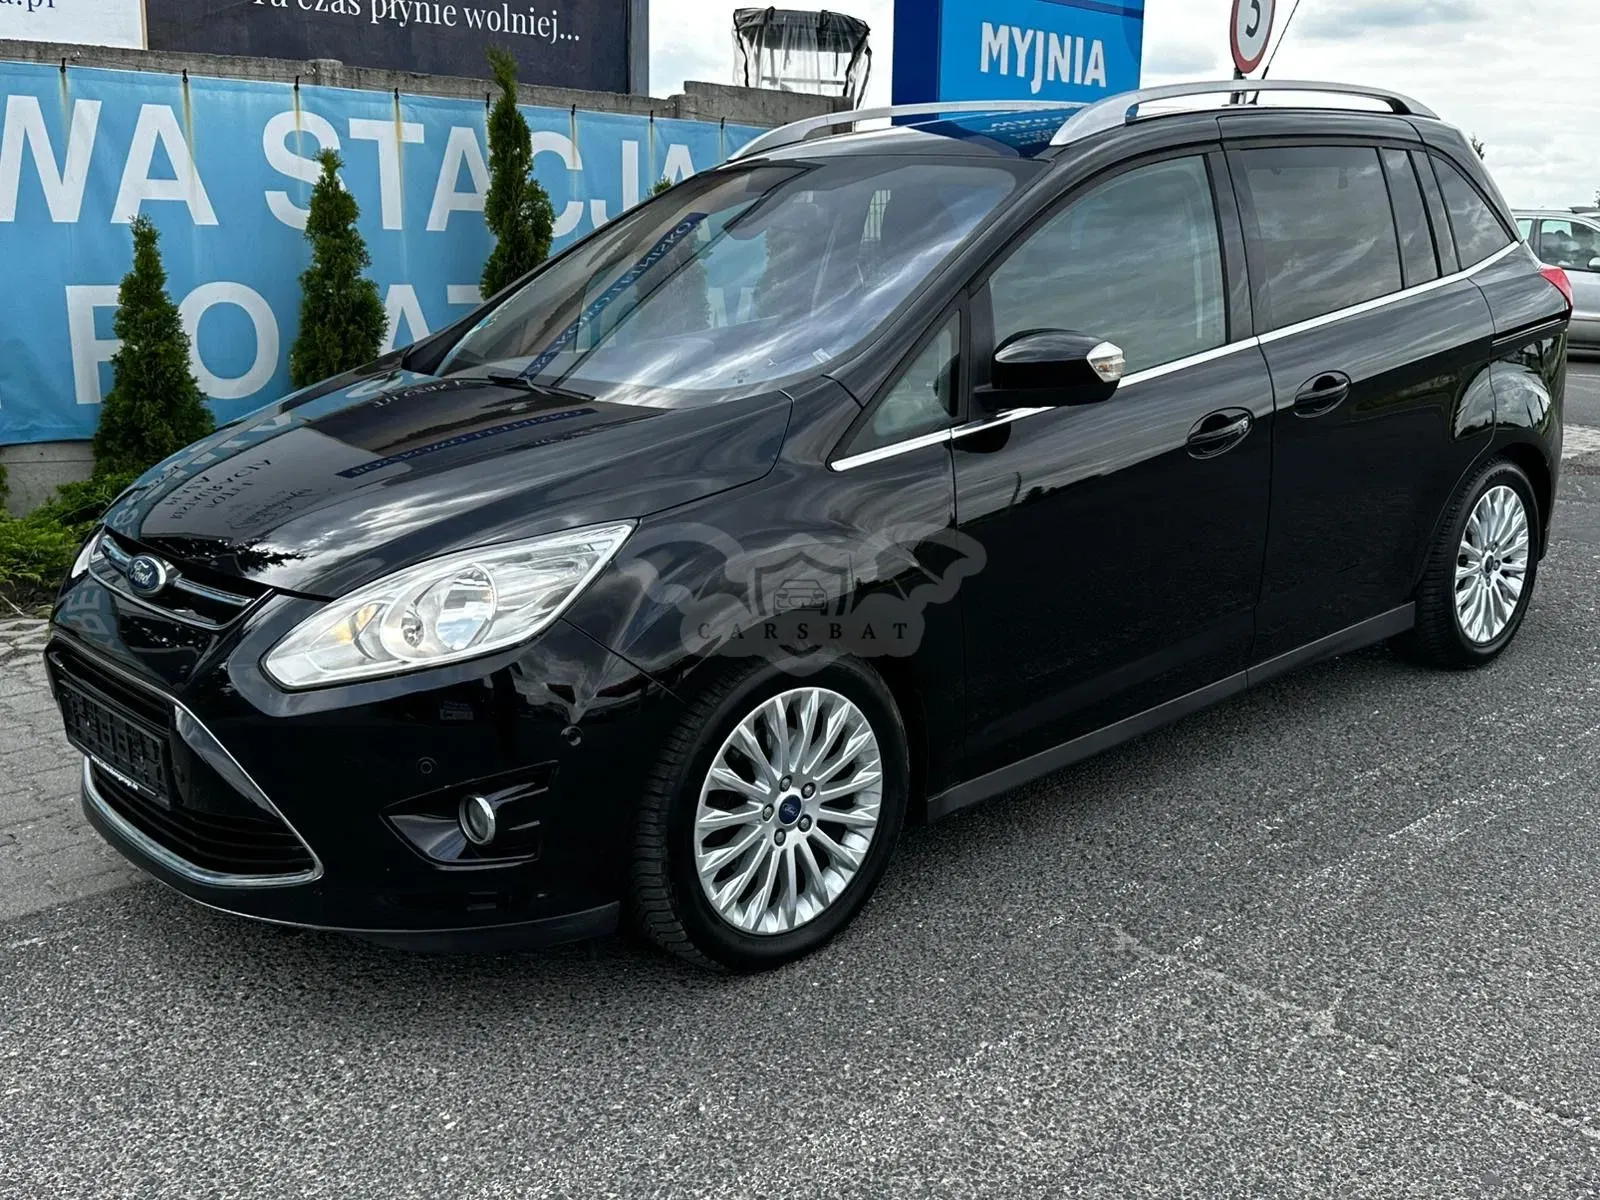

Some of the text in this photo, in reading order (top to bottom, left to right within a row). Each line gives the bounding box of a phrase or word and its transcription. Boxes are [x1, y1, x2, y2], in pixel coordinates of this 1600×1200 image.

[371, 0, 457, 28] płynie
[463, 3, 580, 44] wolniej...
[980, 21, 1107, 95] MYJNIA
